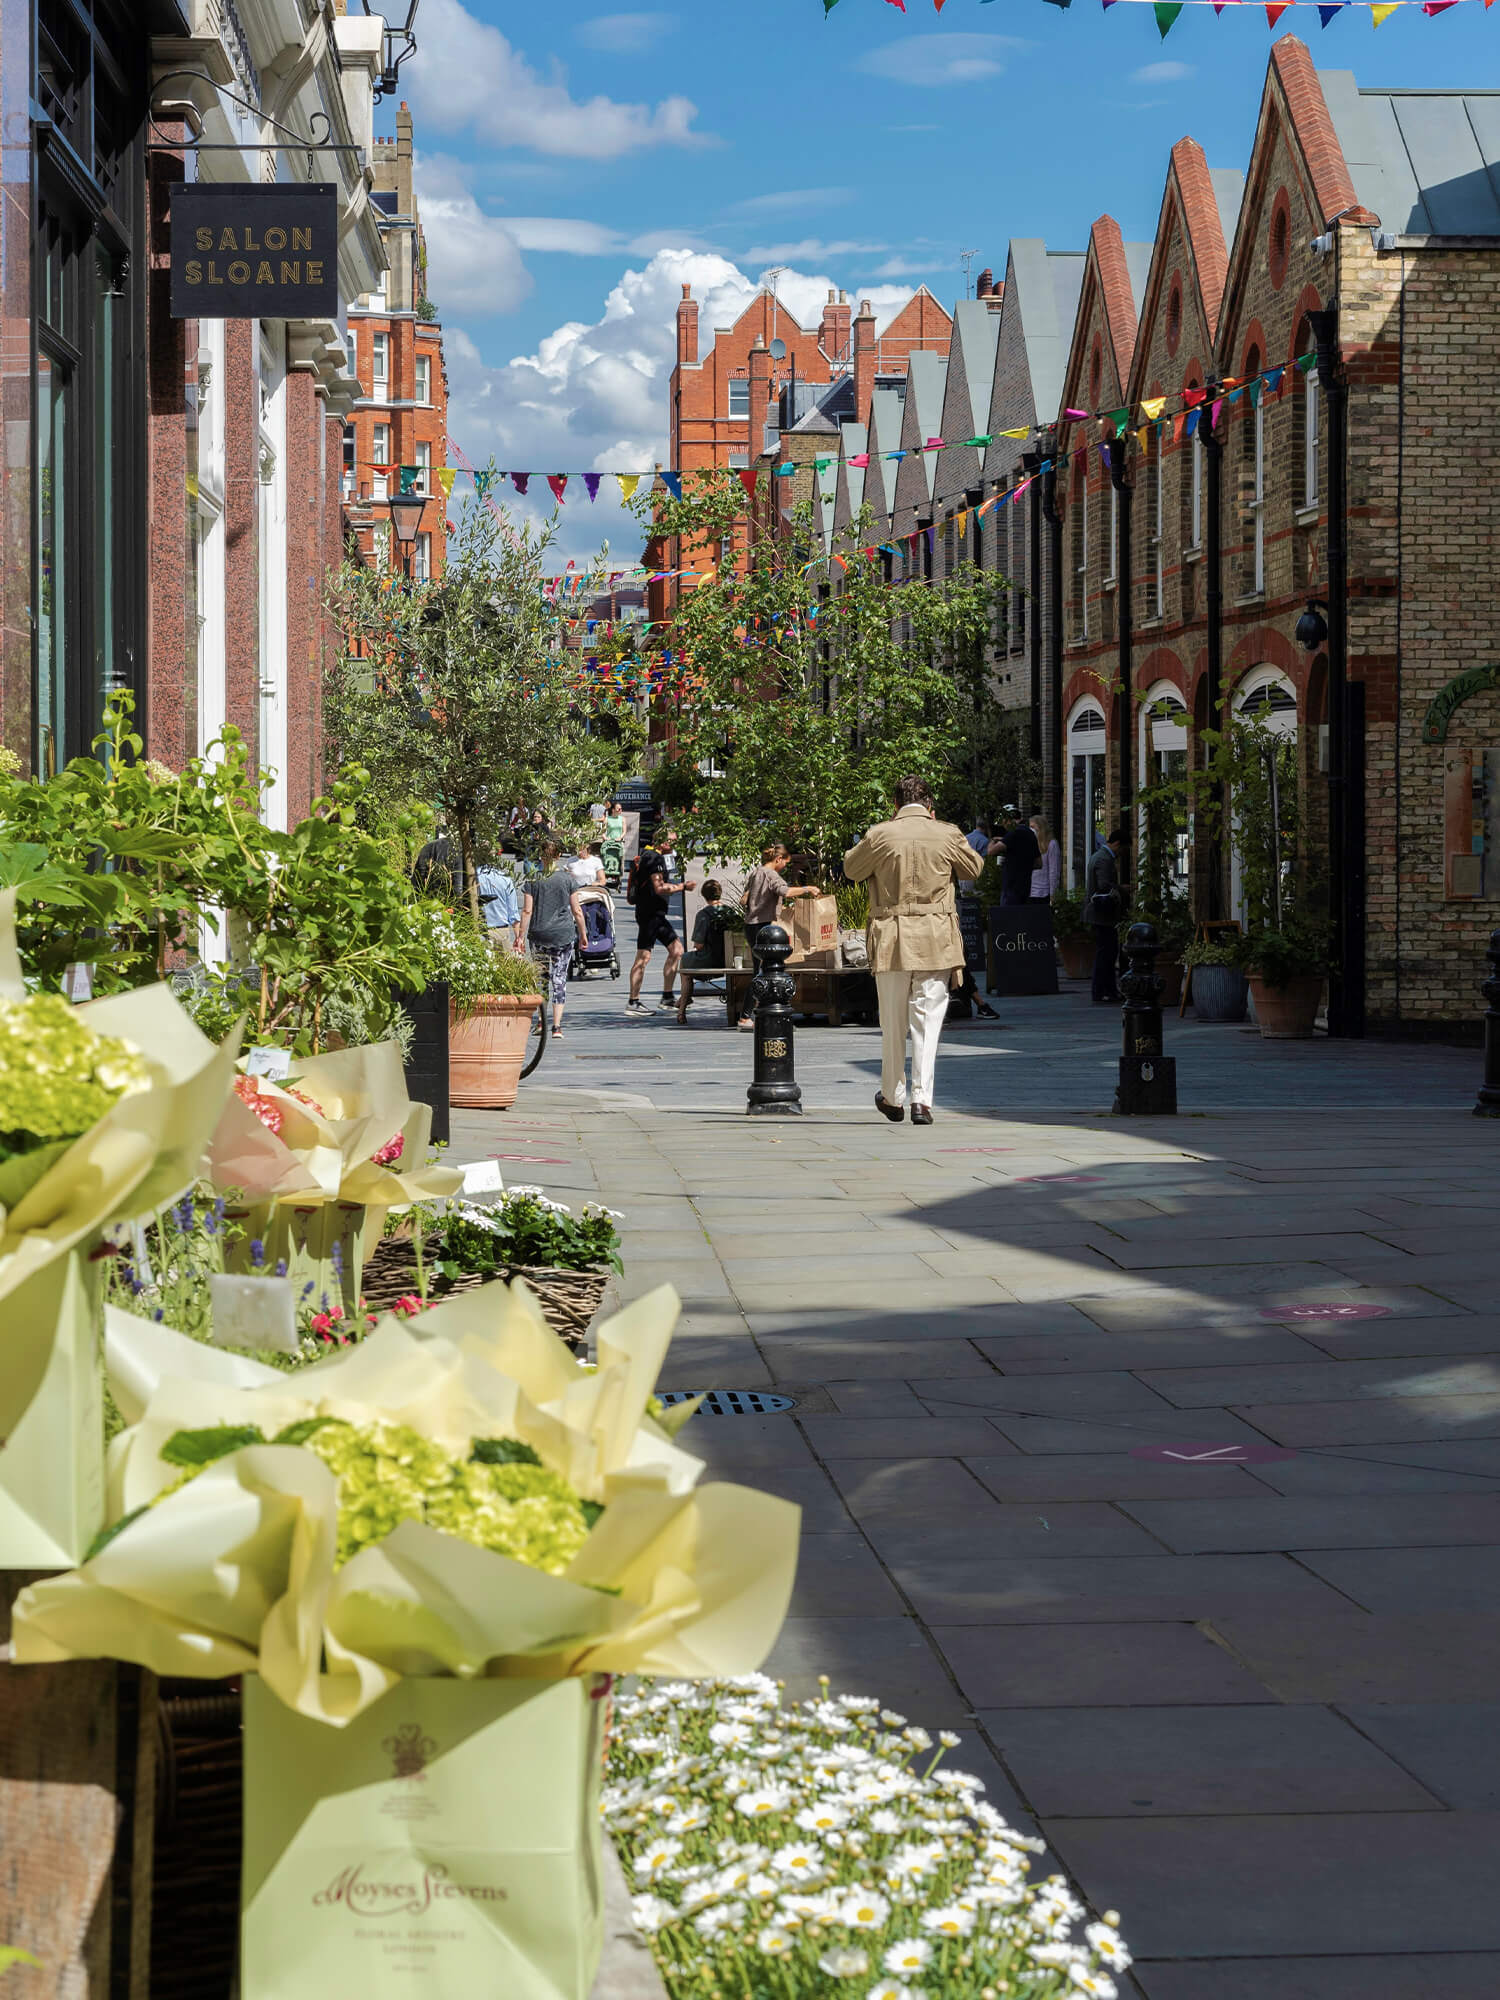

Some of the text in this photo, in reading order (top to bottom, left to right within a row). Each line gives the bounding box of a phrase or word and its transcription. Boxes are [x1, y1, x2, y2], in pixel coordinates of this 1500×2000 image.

[195, 226, 312, 251] SALON
[185, 260, 324, 285] SLOANE
[995, 932, 1048, 951] Coffee
[312, 1862, 508, 1917] Moyses Stevens
